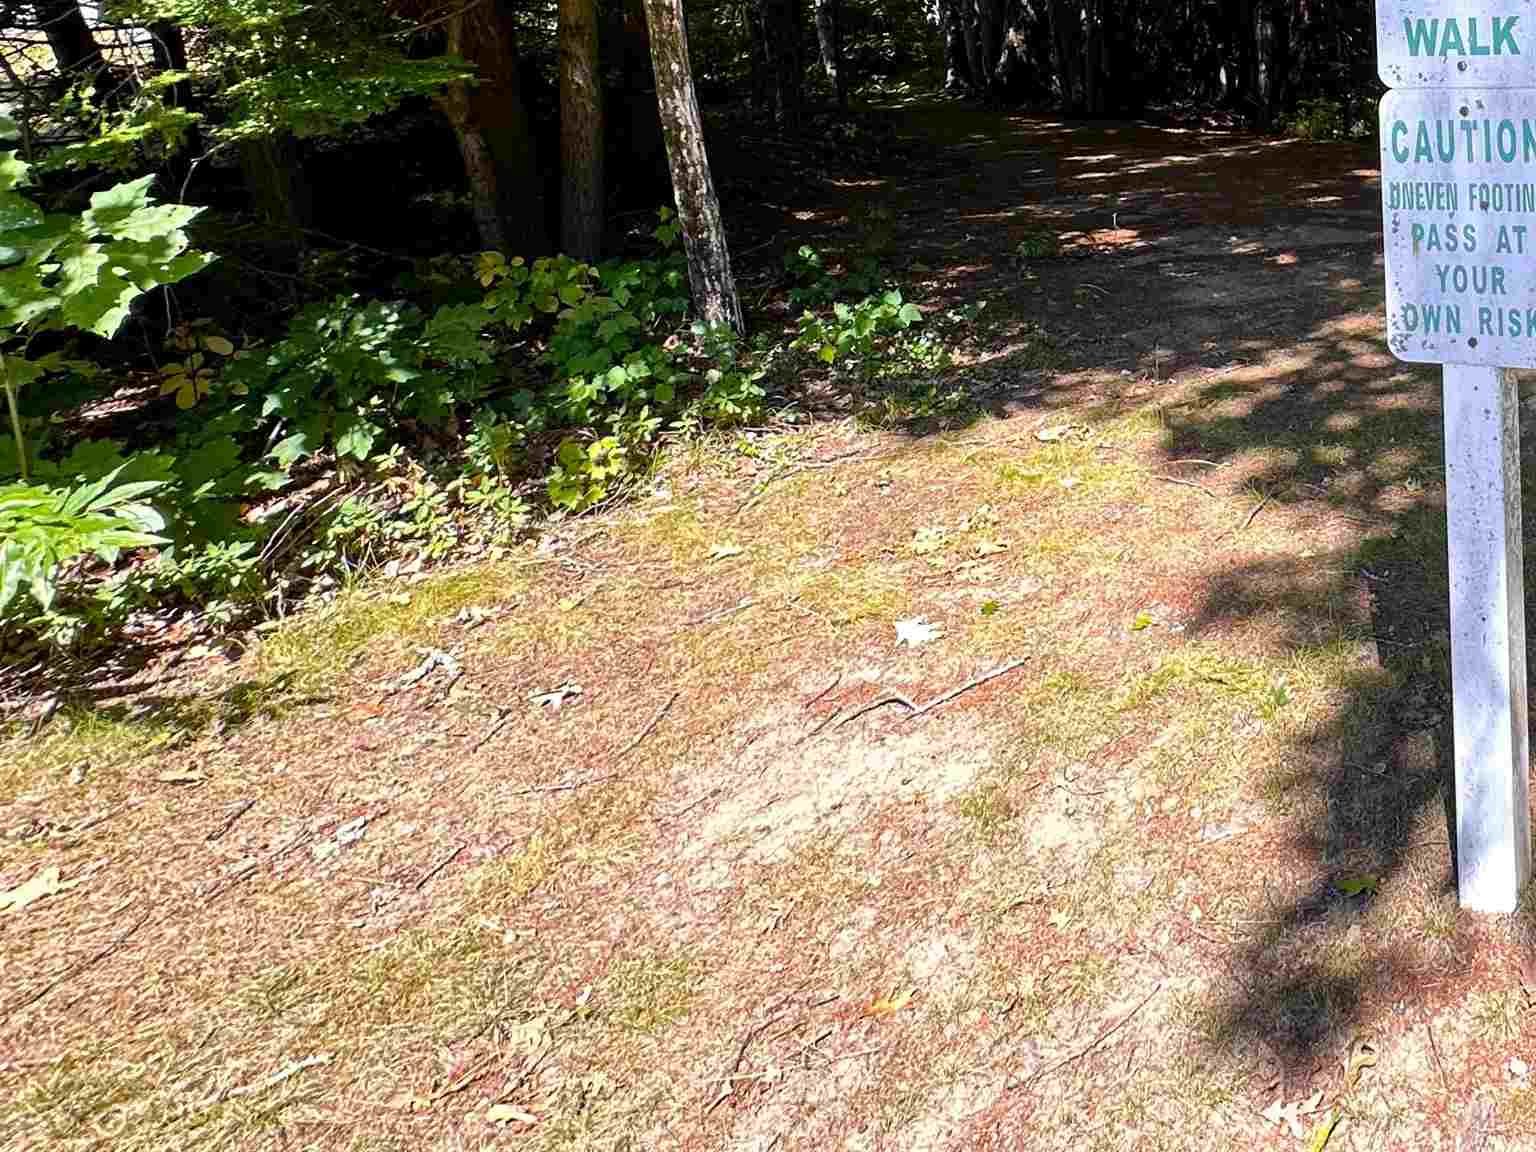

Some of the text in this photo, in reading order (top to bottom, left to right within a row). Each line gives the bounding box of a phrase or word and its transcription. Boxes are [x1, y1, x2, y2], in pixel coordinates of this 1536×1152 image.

[1404, 15, 1521, 56] WALK
[1389, 182, 1458, 211] UNEVEN
[1411, 223, 1528, 254] PASS AT
[1436, 264, 1506, 295] YOUR
[1402, 303, 1461, 334] OWN
